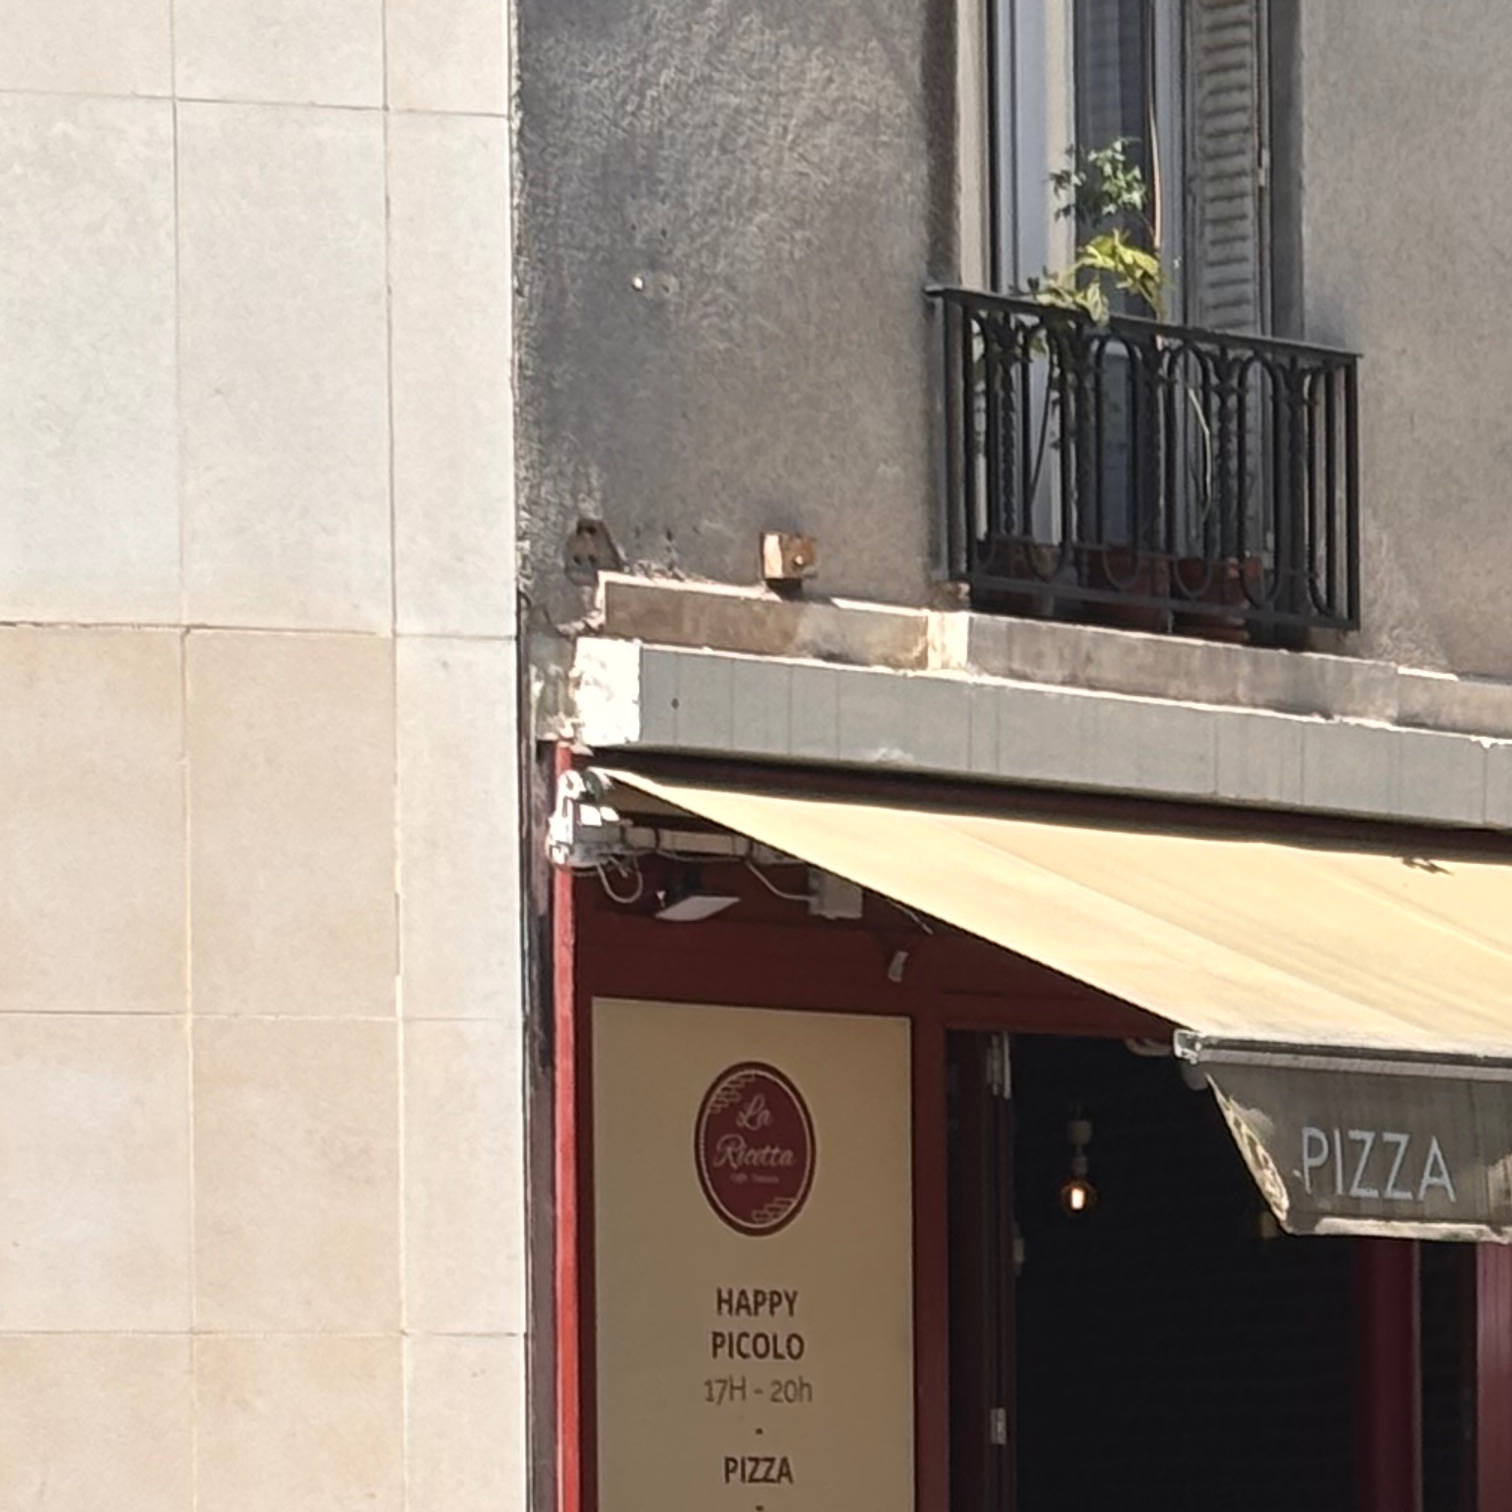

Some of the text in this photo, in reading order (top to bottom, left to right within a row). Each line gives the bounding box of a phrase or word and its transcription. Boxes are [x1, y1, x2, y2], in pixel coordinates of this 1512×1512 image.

[736, 1093, 771, 1131] La
[1302, 1127, 1457, 1202] PIZZA
[716, 1288, 798, 1317] HAPPY
[711, 1331, 805, 1361] PICOLO
[703, 1375, 747, 1405] 17H
[770, 1375, 813, 1404] 20h
[724, 1456, 794, 1484] PIZZA
